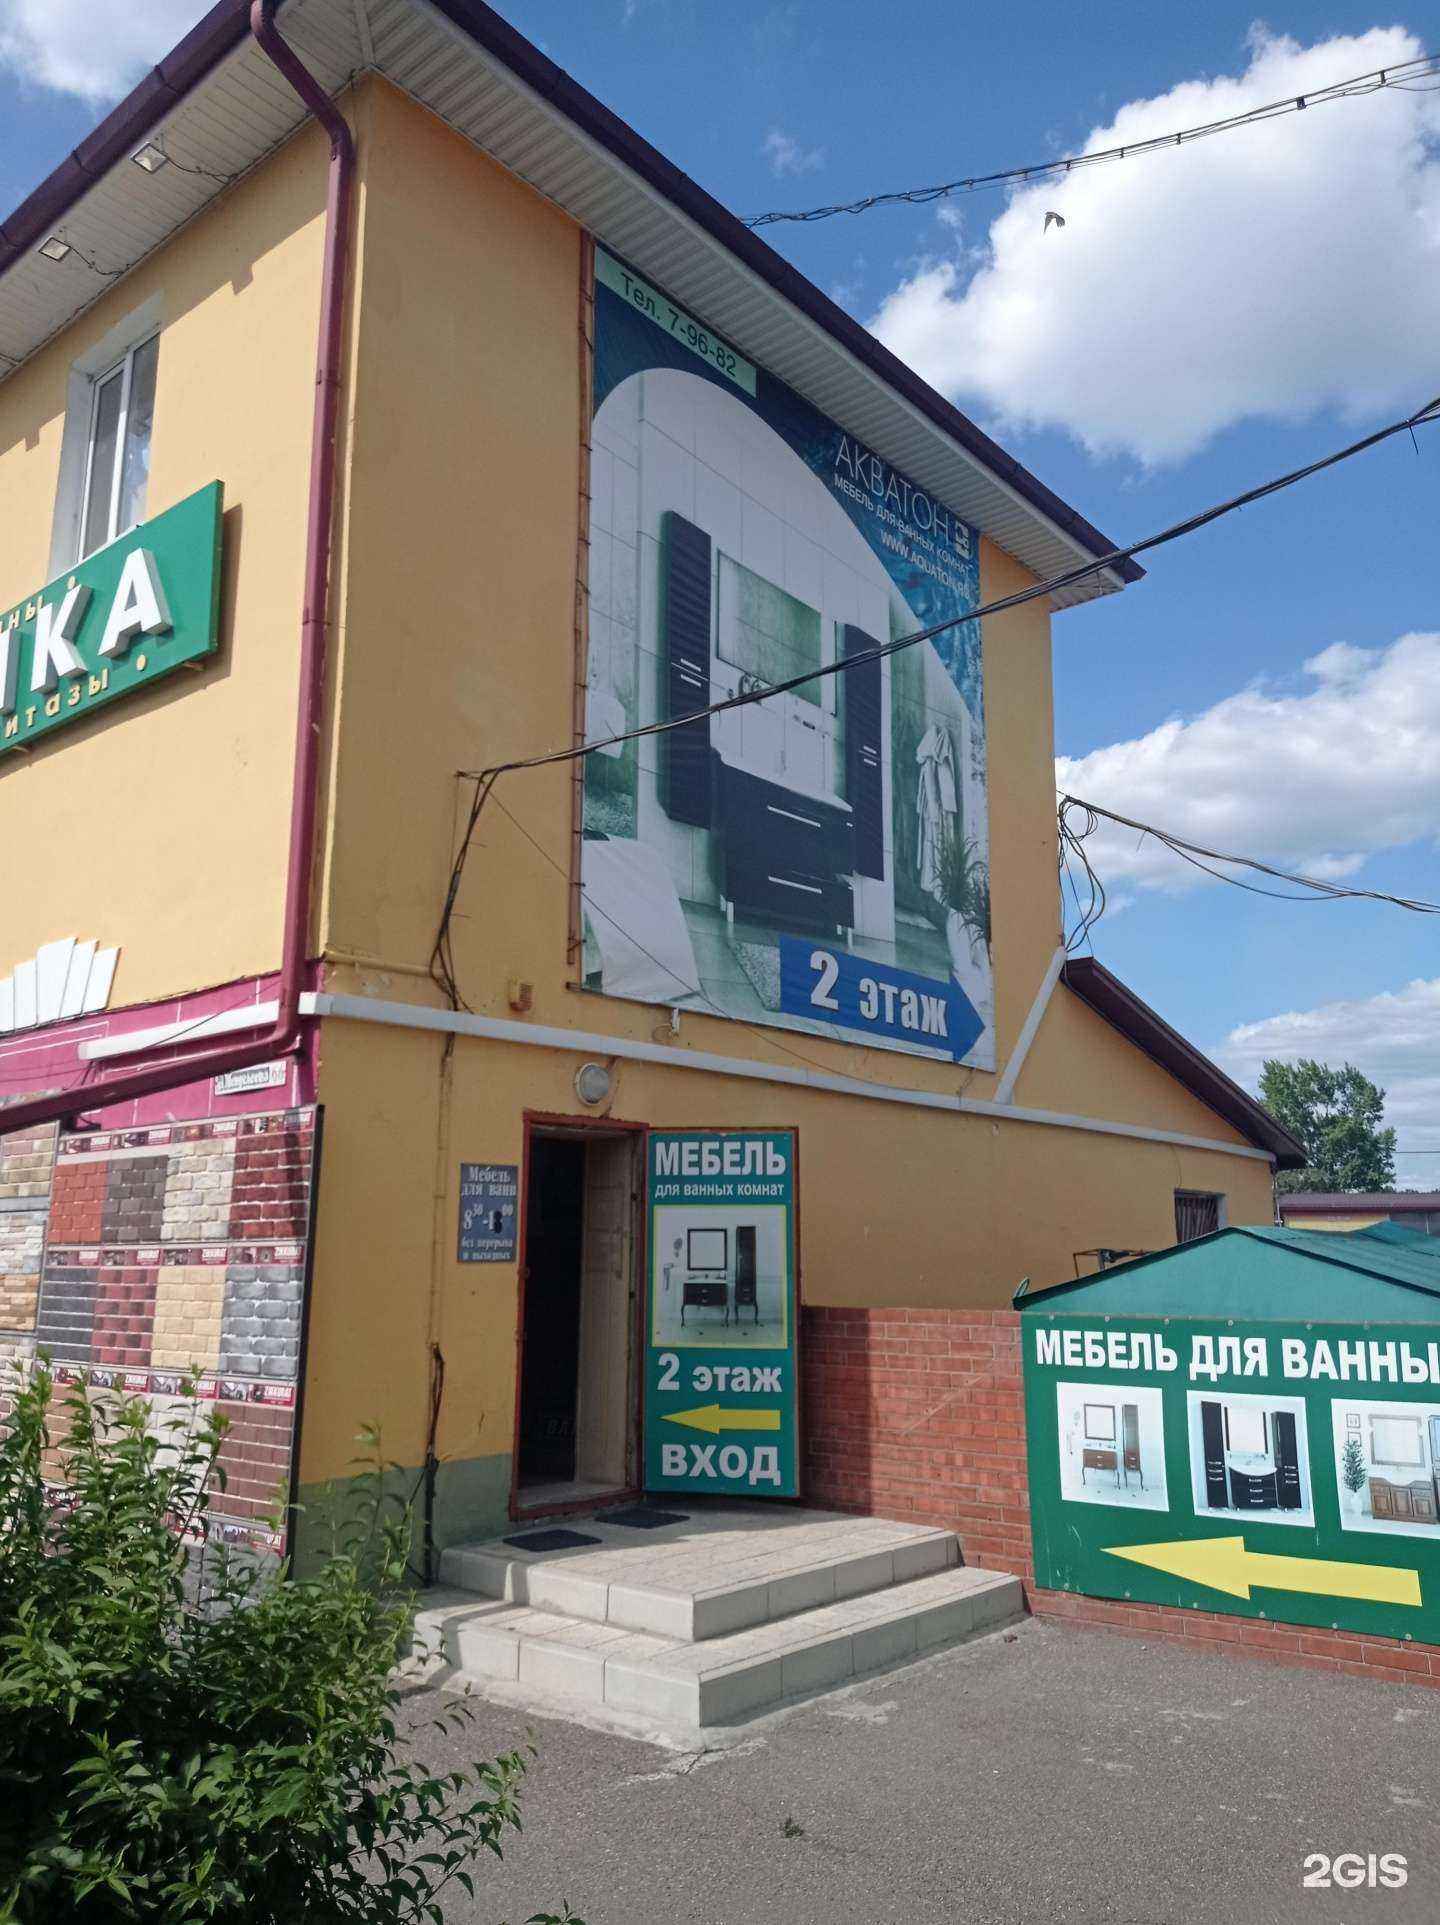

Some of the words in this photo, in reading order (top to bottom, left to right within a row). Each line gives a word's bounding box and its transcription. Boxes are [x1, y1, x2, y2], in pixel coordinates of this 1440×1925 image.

[611, 272, 660, 321] Тел.
[668, 308, 737, 377] 7-96-82
[833, 472, 874, 512] МЕБЕЛЬ
[876, 504, 896, 526] ДЛЯ
[898, 518, 935, 553] ВАННЫХ
[835, 435, 949, 546] АКВАТОН
[810, 950, 840, 1010] 2
[858, 977, 948, 1037] этаж
[655, 1141, 786, 1176] МЕБЕЛЬ
[655, 1184, 680, 1198] для
[684, 1184, 733, 1196] ванных
[737, 1184, 785, 1196] комнат
[658, 1353, 679, 1391] 2
[692, 1365, 782, 1392] этаж
[1035, 1329, 1178, 1372] МЕБЕЛЬ
[1189, 1335, 1268, 1382] ДЛЯ
[1282, 1338, 1440, 1384] ВАННЫ
[661, 1444, 781, 1486] ВХОД
